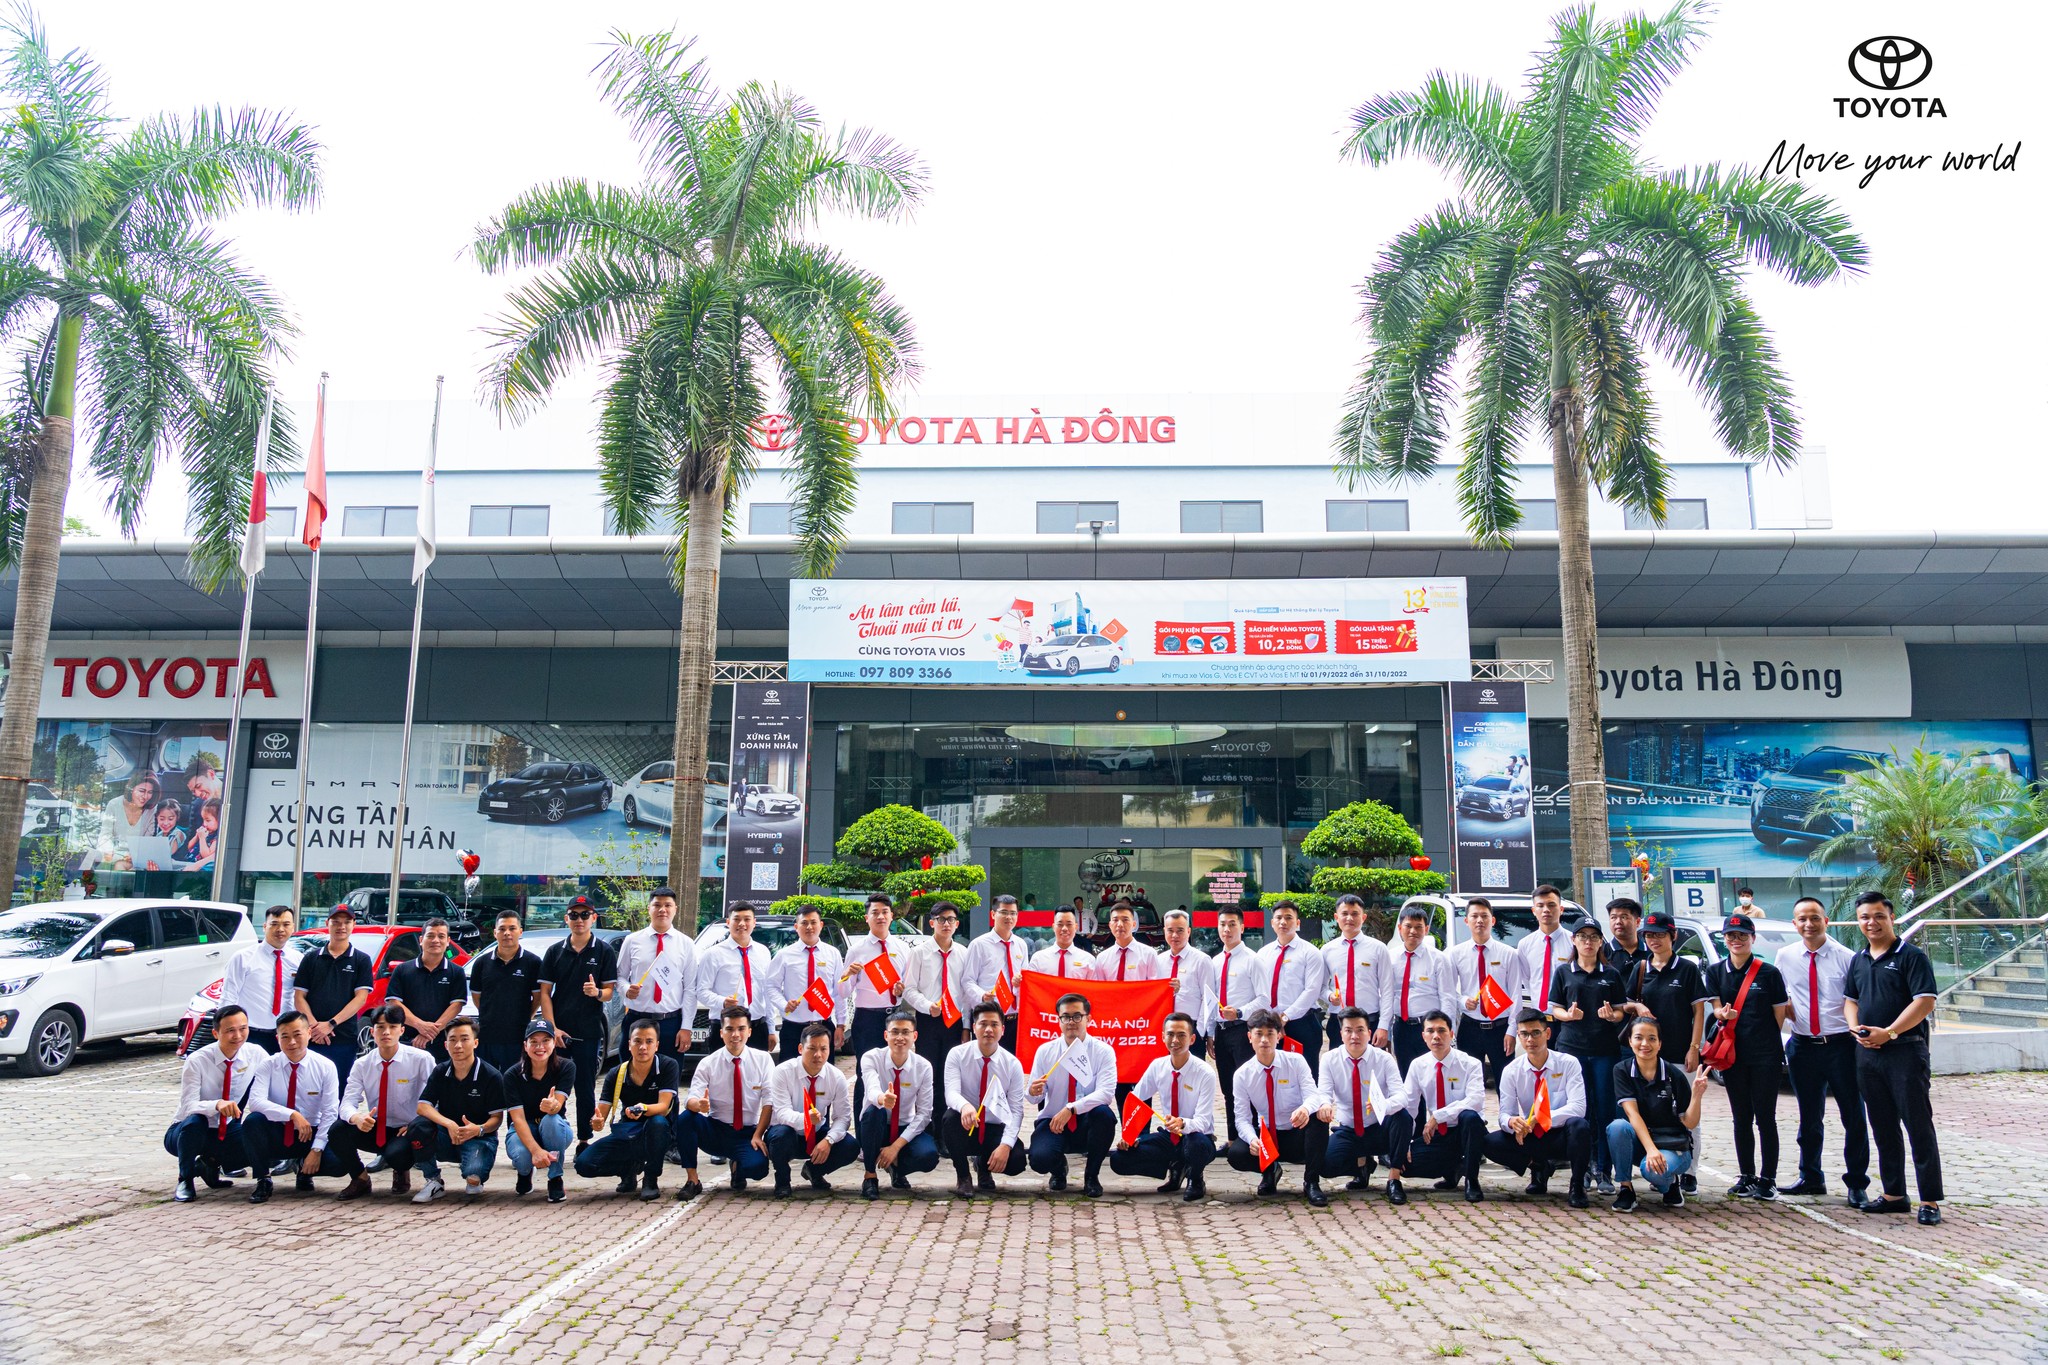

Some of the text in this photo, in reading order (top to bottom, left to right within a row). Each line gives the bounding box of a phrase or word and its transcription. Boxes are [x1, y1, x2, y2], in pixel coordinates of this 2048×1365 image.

[817, 407, 1176, 445] OYOTA HÀ ĐÔNG
[849, 604, 875, 621] An
[879, 602, 904, 618] tâm
[908, 597, 936, 616] cầm
[901, 617, 928, 634] mái
[931, 616, 944, 632] vi
[947, 618, 963, 631] vu
[1186, 626, 1200, 634] KIỆN
[1350, 624, 1361, 632] GÓI
[1362, 624, 1377, 632] QUÀ
[858, 644, 966, 656] CÙNG TOYOTA VIOS
[1258, 639, 1285, 651] 10,2
[1355, 639, 1370, 650] 15
[53, 656, 278, 698] TOYOTA
[859, 667, 884, 679] 097
[889, 667, 914, 679] 809
[918, 667, 953, 679] 3366
[1349, 670, 1363, 678] đến
[1598, 660, 1842, 699] oyota Hà Đông
[746, 732, 790, 741] XỨNG TẦM
[773, 741, 799, 749] NHÂN
[257, 751, 292, 759] TOYOTA
[1626, 792, 1658, 805] ĐẦU
[1663, 796, 1683, 805] XU
[1687, 791, 1718, 805] THẾ
[377, 825, 456, 850] NHÂN
[1096, 883, 1134, 893] OYOTA
[1687, 888, 1704, 907] B
[811, 987, 831, 1009] HILUX
[1039, 1012, 1149, 1031] TOA HÀ NỘI
[1118, 1036, 1157, 1046] 2022
